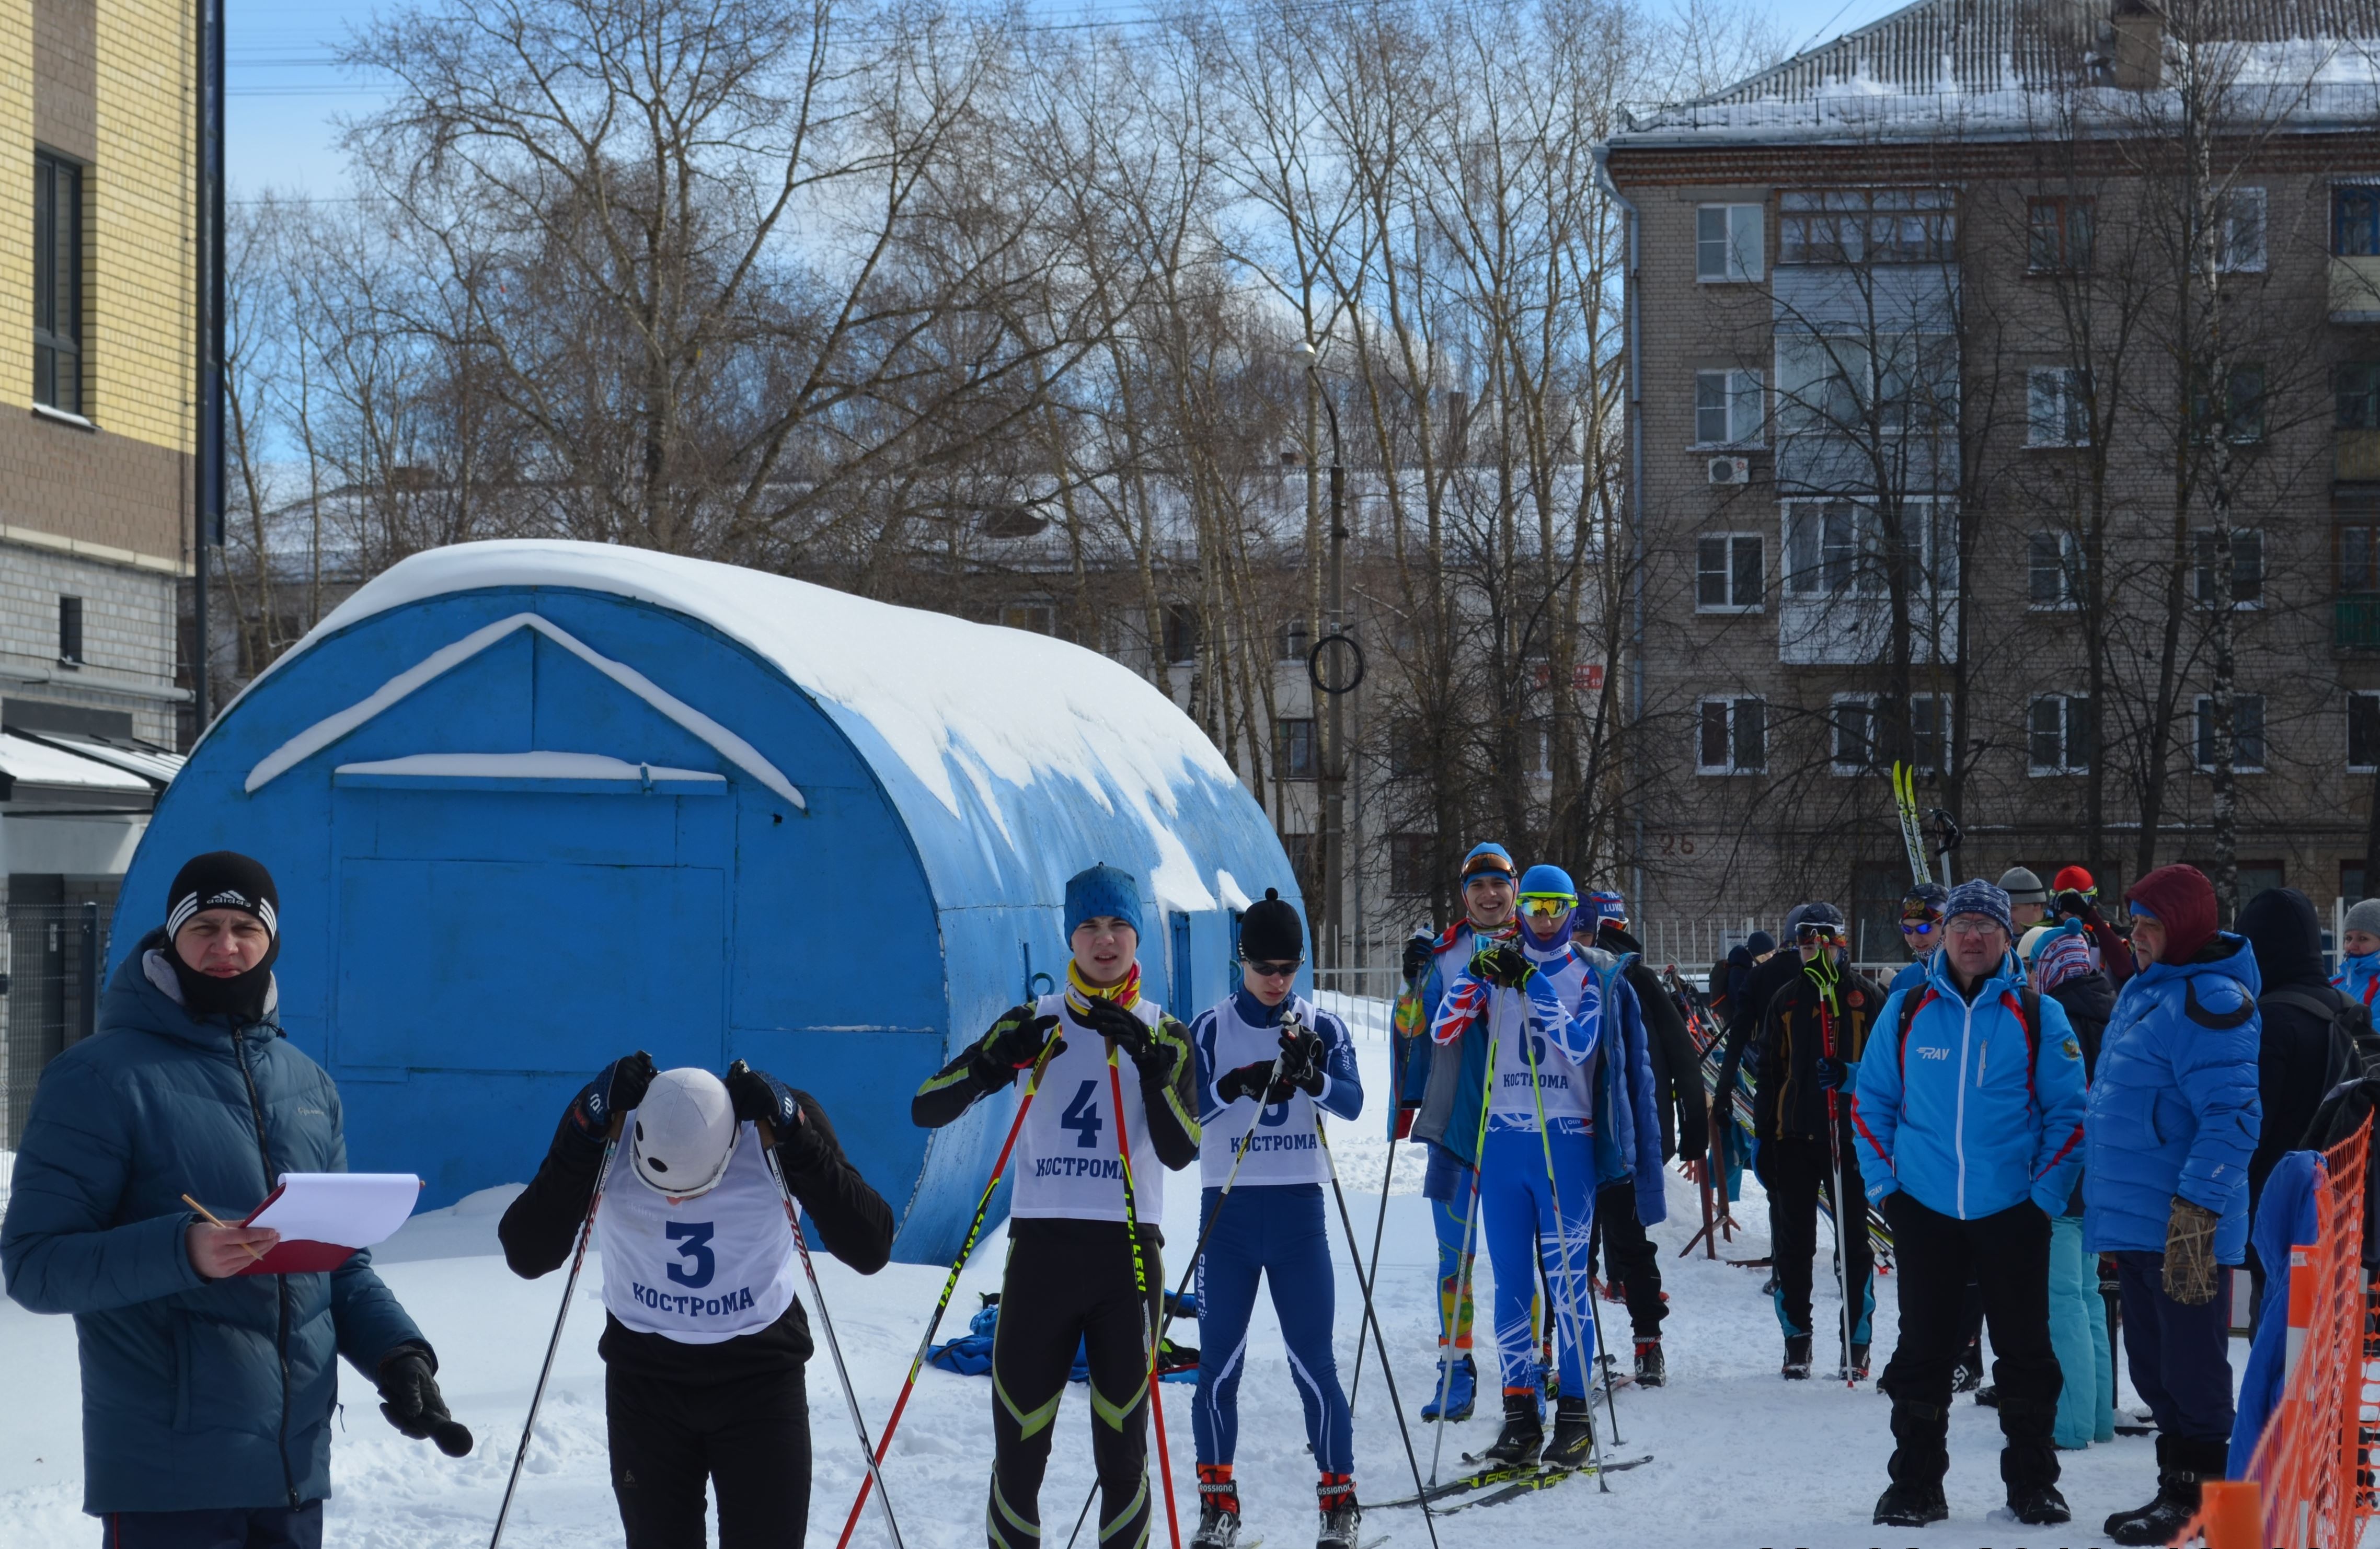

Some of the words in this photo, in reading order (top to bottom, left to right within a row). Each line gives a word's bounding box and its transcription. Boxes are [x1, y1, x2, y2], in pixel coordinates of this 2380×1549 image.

[206, 897, 251, 907] adidas
[1519, 1017, 1546, 1066] 6
[1061, 1080, 1102, 1148] 4
[665, 1220, 715, 1289] 3
[1133, 1244, 1146, 1291] LEKI
[633, 1282, 755, 1317] КОСТРОМА
[939, 1260, 962, 1307] LEKI
[1567, 1438, 1589, 1454] FISCHER
